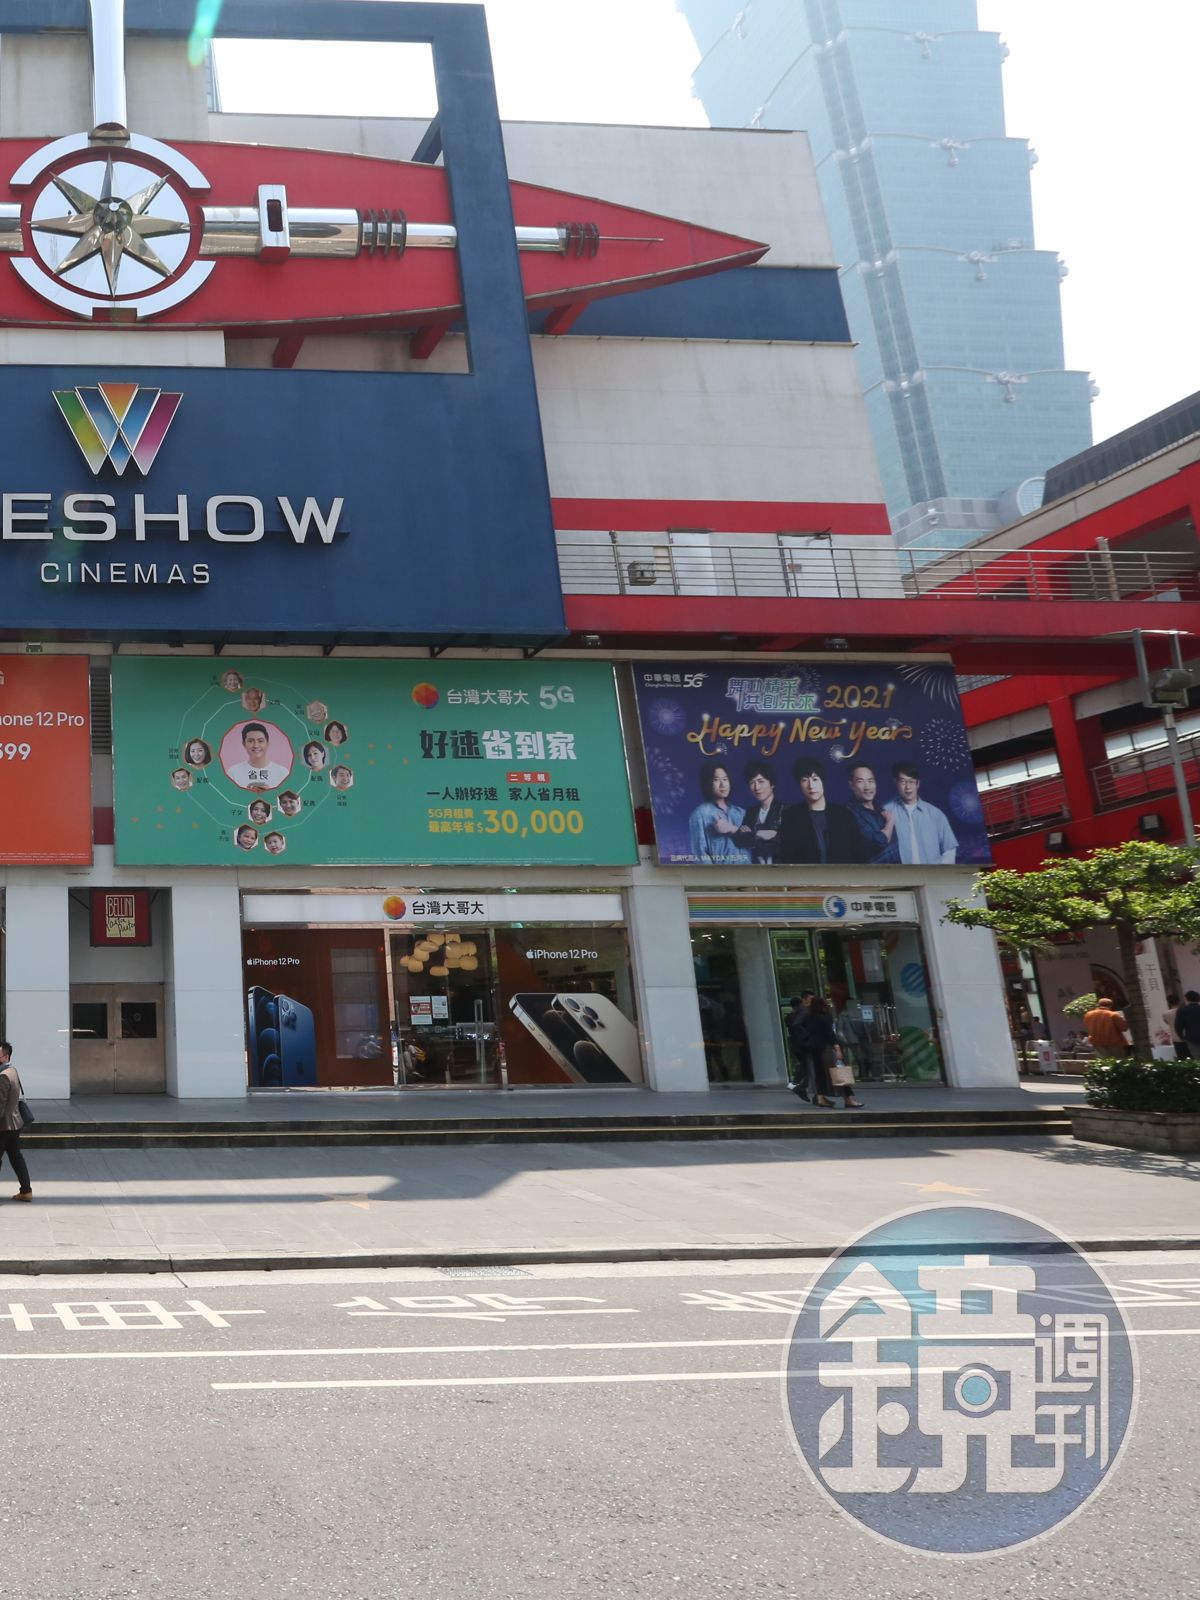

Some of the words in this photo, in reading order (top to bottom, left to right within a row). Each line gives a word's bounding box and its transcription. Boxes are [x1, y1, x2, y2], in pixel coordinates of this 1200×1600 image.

[41, 562, 210, 585] CINEMAS
[683, 673, 704, 688] 5G
[447, 689, 530, 705] 台灣大哥大
[539, 685, 575, 709] 5G
[823, 685, 894, 709] 2021
[36, 712, 54, 726] 12
[57, 712, 85, 727] Pro
[687, 716, 785, 756] Happy
[789, 716, 846, 743] New
[420, 729, 577, 760] 好速省到家
[248, 769, 269, 781] 省長
[427, 787, 498, 801] 一人辦好速
[509, 787, 580, 801] 家人省月租
[428, 808, 474, 819] 5G月租費
[428, 820, 474, 833] 最高年省
[477, 809, 584, 838] $30,000
[108, 897, 133, 917] BELLINI
[412, 901, 484, 916] 台灣大哥大
[851, 901, 897, 912] 中華電信
[252, 958, 278, 966] iPhone
[278, 957, 287, 965] 12
[288, 957, 300, 965] Pro
[534, 949, 568, 959] iPhone
[569, 949, 580, 958] 12
[581, 949, 598, 959] Pro
